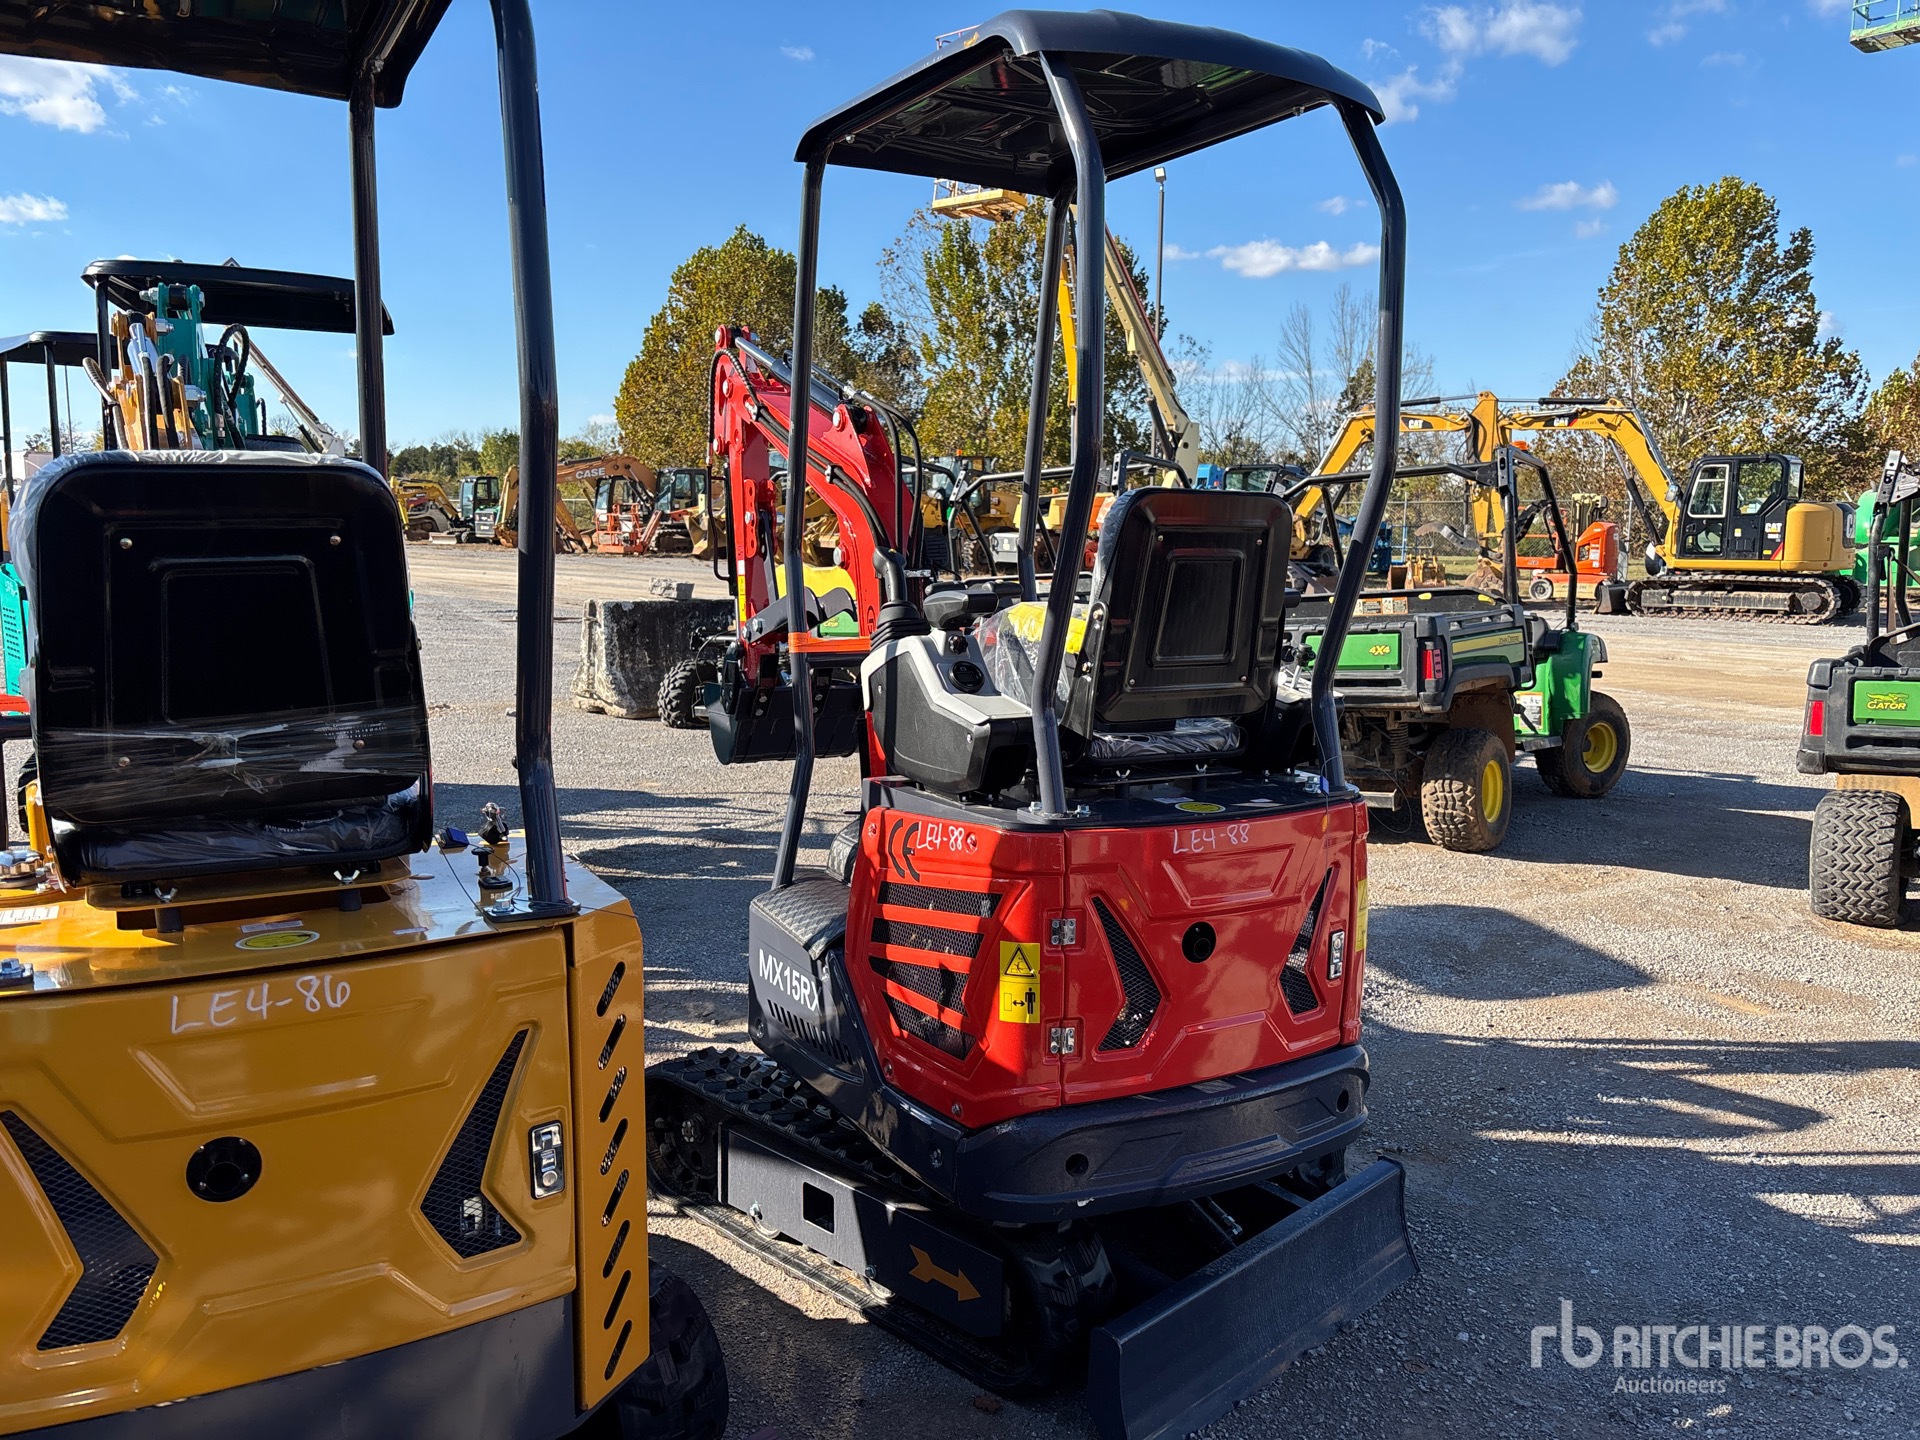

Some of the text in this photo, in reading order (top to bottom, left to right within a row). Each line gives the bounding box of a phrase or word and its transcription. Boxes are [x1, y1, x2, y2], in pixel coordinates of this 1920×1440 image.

[1408, 419, 1424, 429] CAT
[1553, 417, 1569, 427] CAT
[575, 467, 606, 480] CASE
[1765, 522, 1783, 533] CAT
[1867, 700, 1908, 710] GATOR
[1172, 823, 1251, 855] LE4-88
[169, 974, 352, 1035] LE4-86
